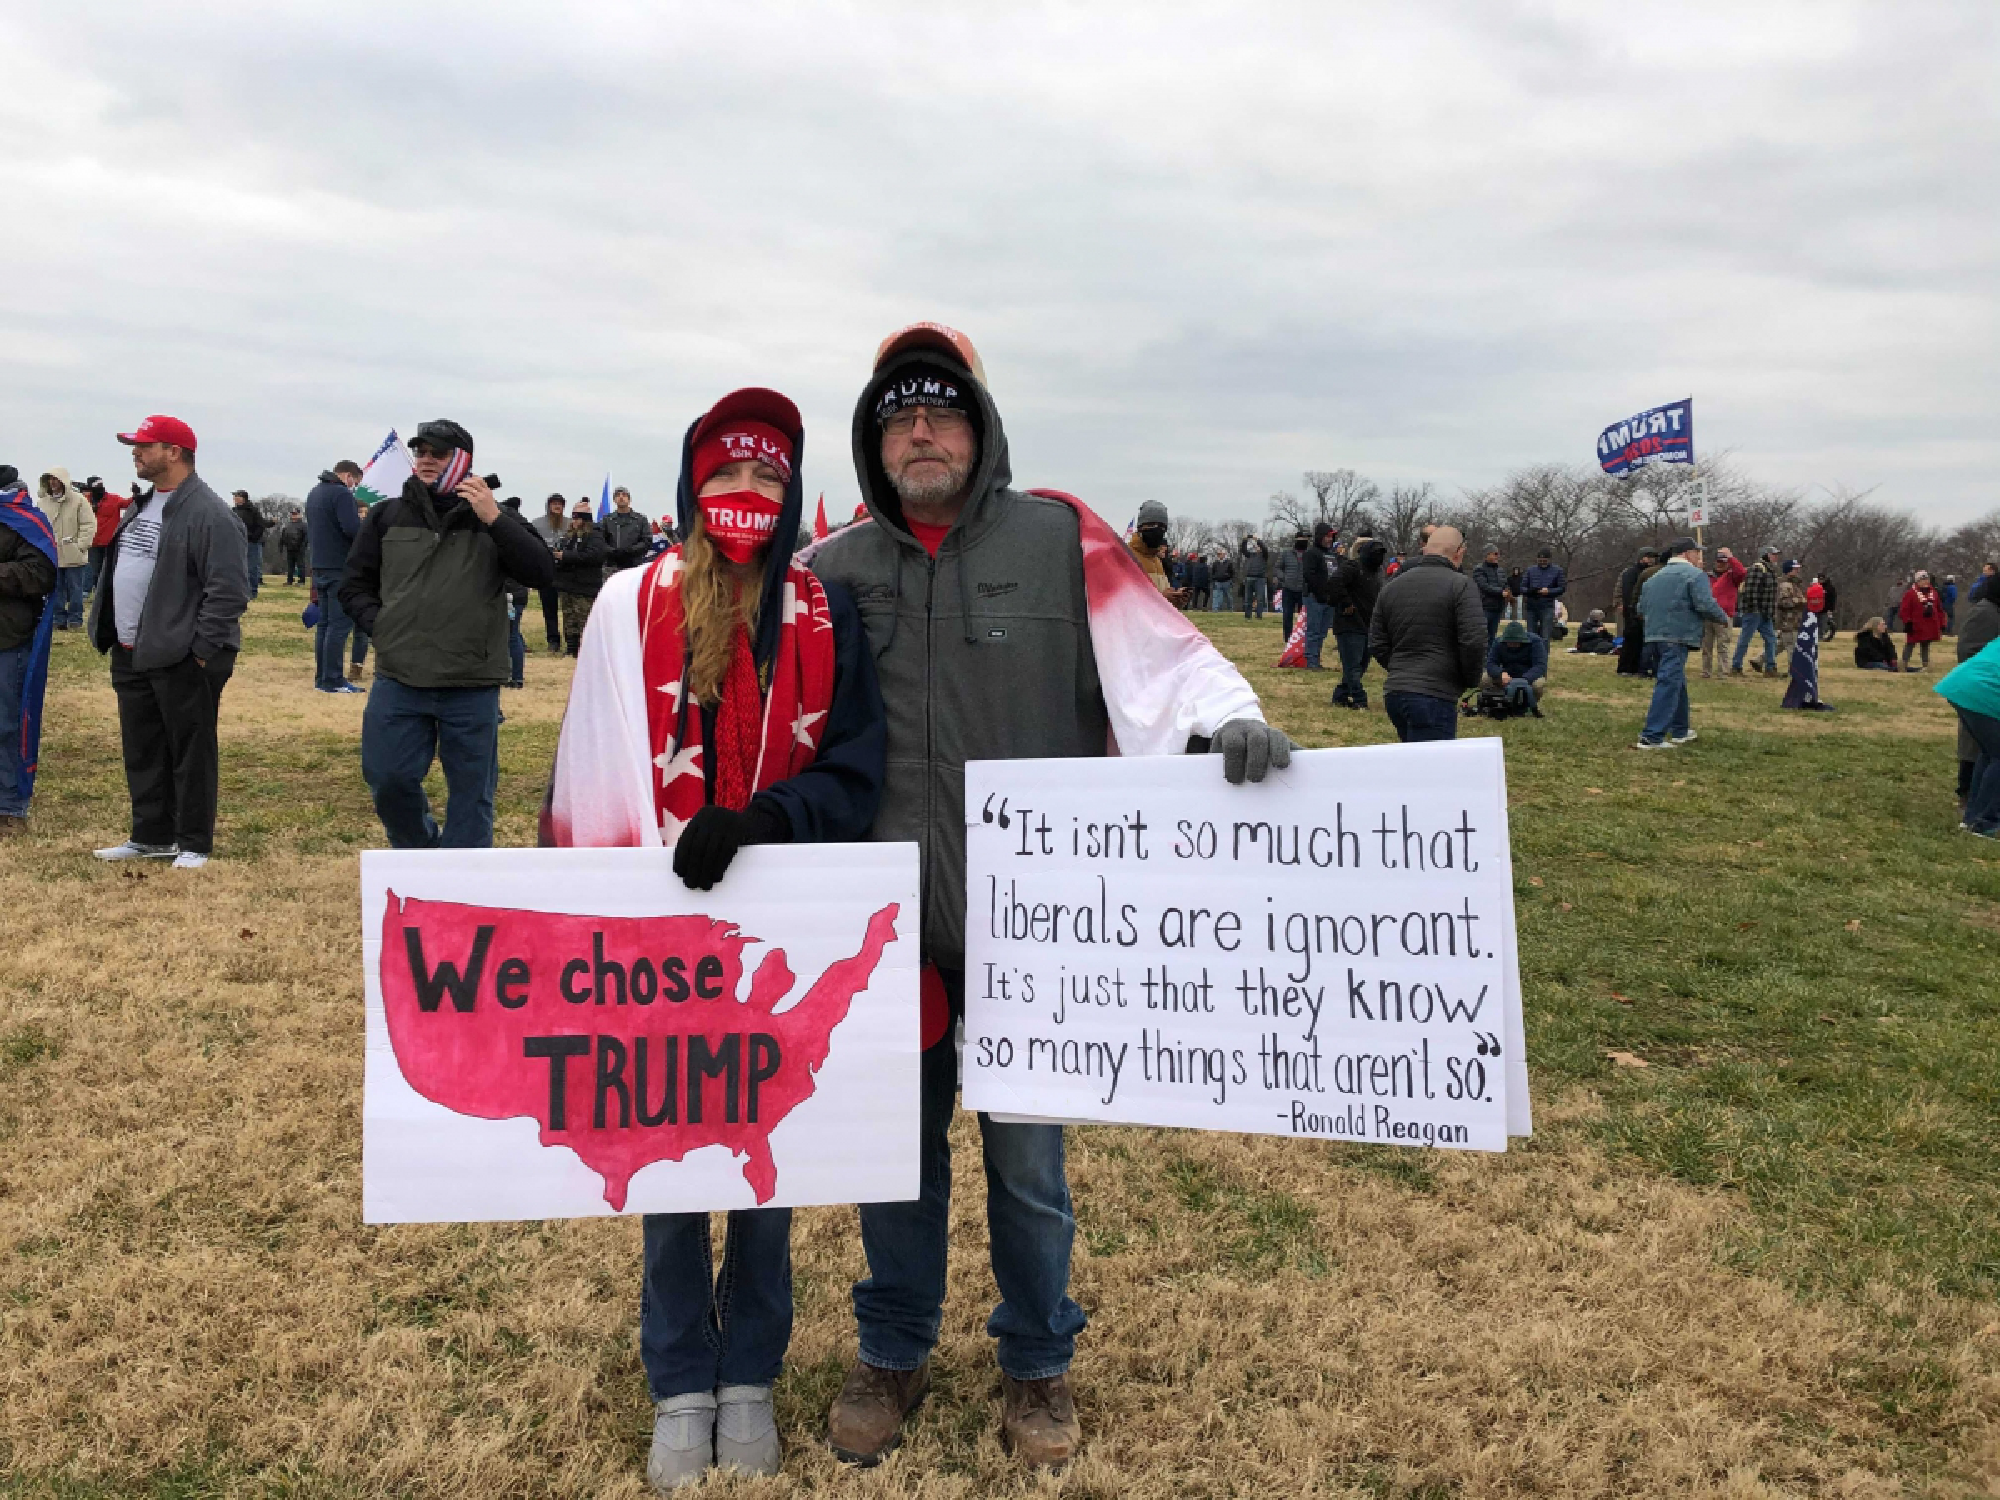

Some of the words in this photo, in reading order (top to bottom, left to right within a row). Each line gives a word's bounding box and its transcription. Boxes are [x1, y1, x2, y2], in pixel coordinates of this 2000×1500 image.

[1073, 809, 1149, 860] isn't
[1175, 820, 1218, 859] so
[1233, 802, 1360, 867] much
[1373, 804, 1479, 872] that
[987, 875, 1138, 947] liberals
[1159, 907, 1242, 950] are
[1267, 897, 1494, 983] ignorant.
[404, 925, 532, 1013] We
[560, 931, 725, 1006] chose
[982, 962, 1035, 1003] It's
[1053, 965, 1128, 1024] just
[1140, 964, 1214, 1013] that
[1235, 967, 1325, 1041] they
[1347, 968, 1488, 1023] know
[524, 1032, 782, 1131] TRUMP
[977, 1036, 1014, 1068] so
[1029, 1037, 1128, 1104] many
[1138, 1028, 1247, 1105] things
[1258, 1032, 1324, 1093] that
[1335, 1038, 1436, 1099] aren't
[1374, 1104, 1469, 1147] Reagan
